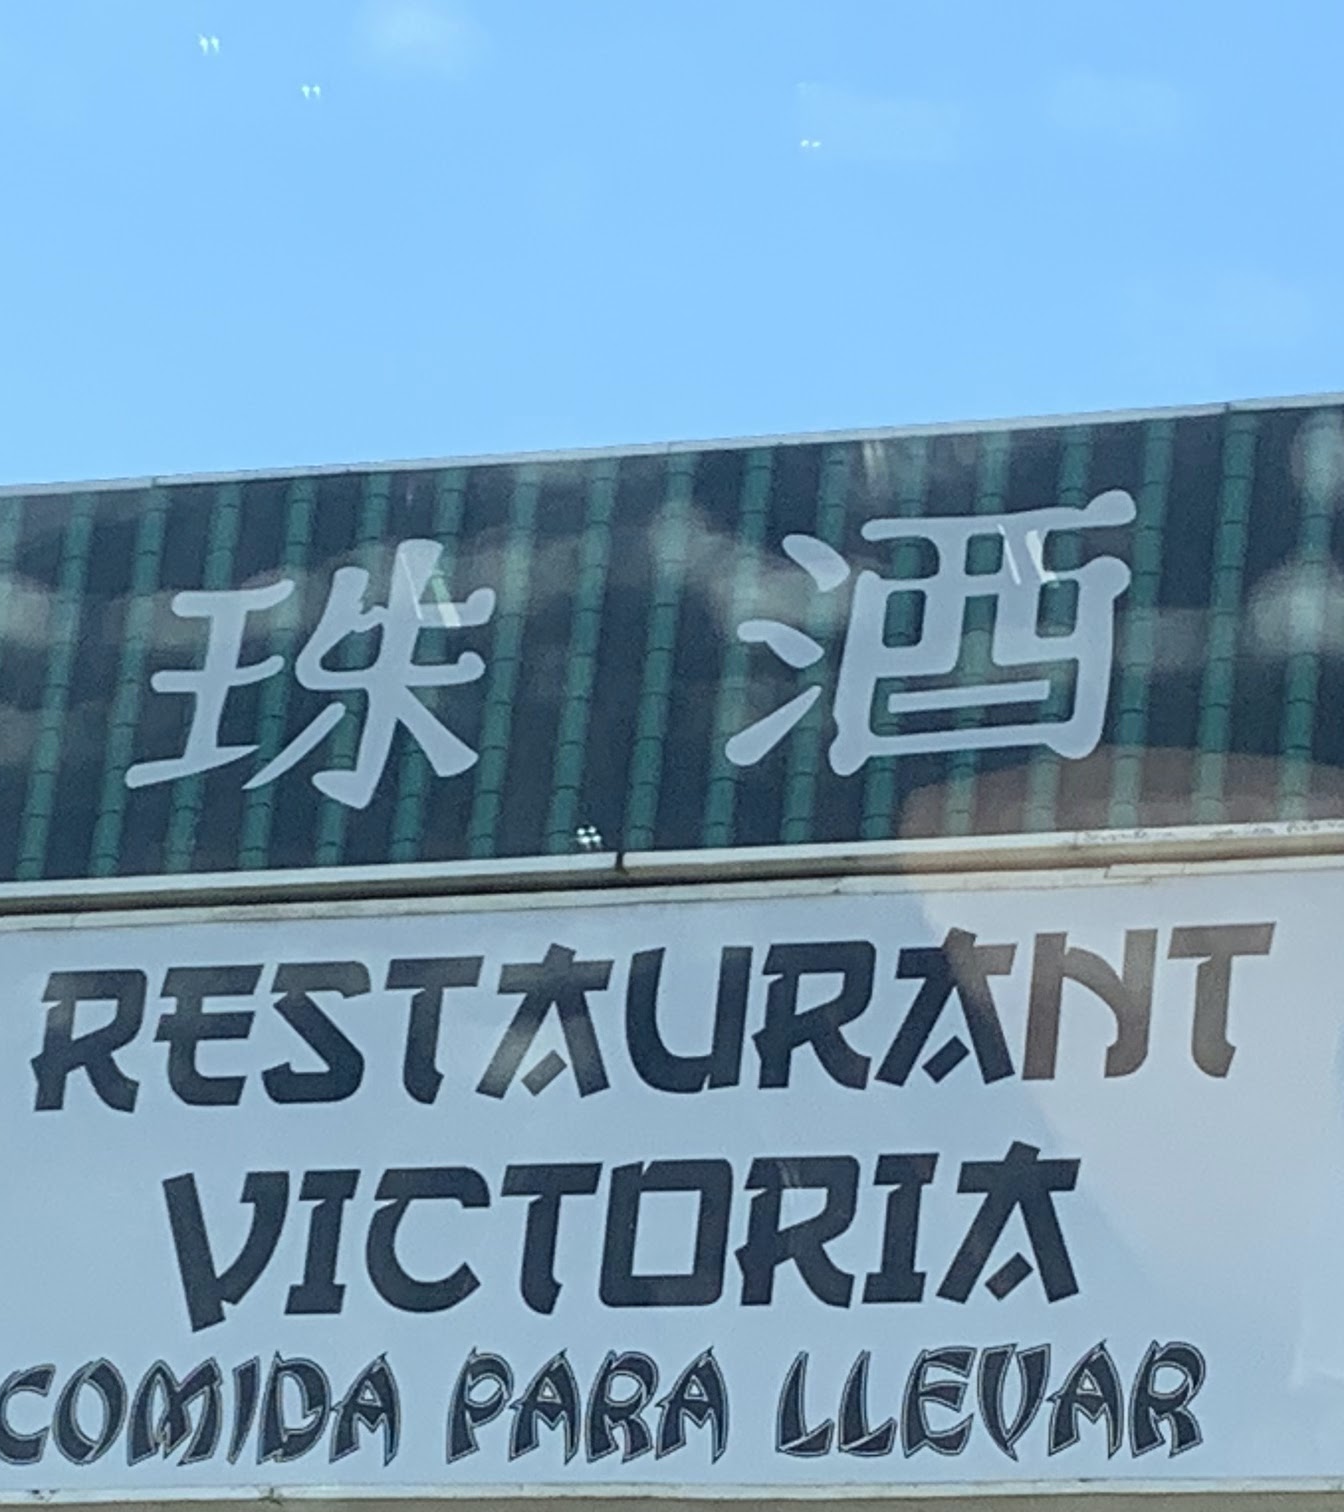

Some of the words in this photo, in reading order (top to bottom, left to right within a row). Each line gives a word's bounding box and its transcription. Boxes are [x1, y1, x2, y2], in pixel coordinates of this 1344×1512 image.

[35, 921, 1275, 1113] RESTAURANT
[161, 1140, 1081, 1332] VICTORIA
[446, 1347, 728, 1467] PARA
[776, 1340, 1206, 1461] LLEVAR
